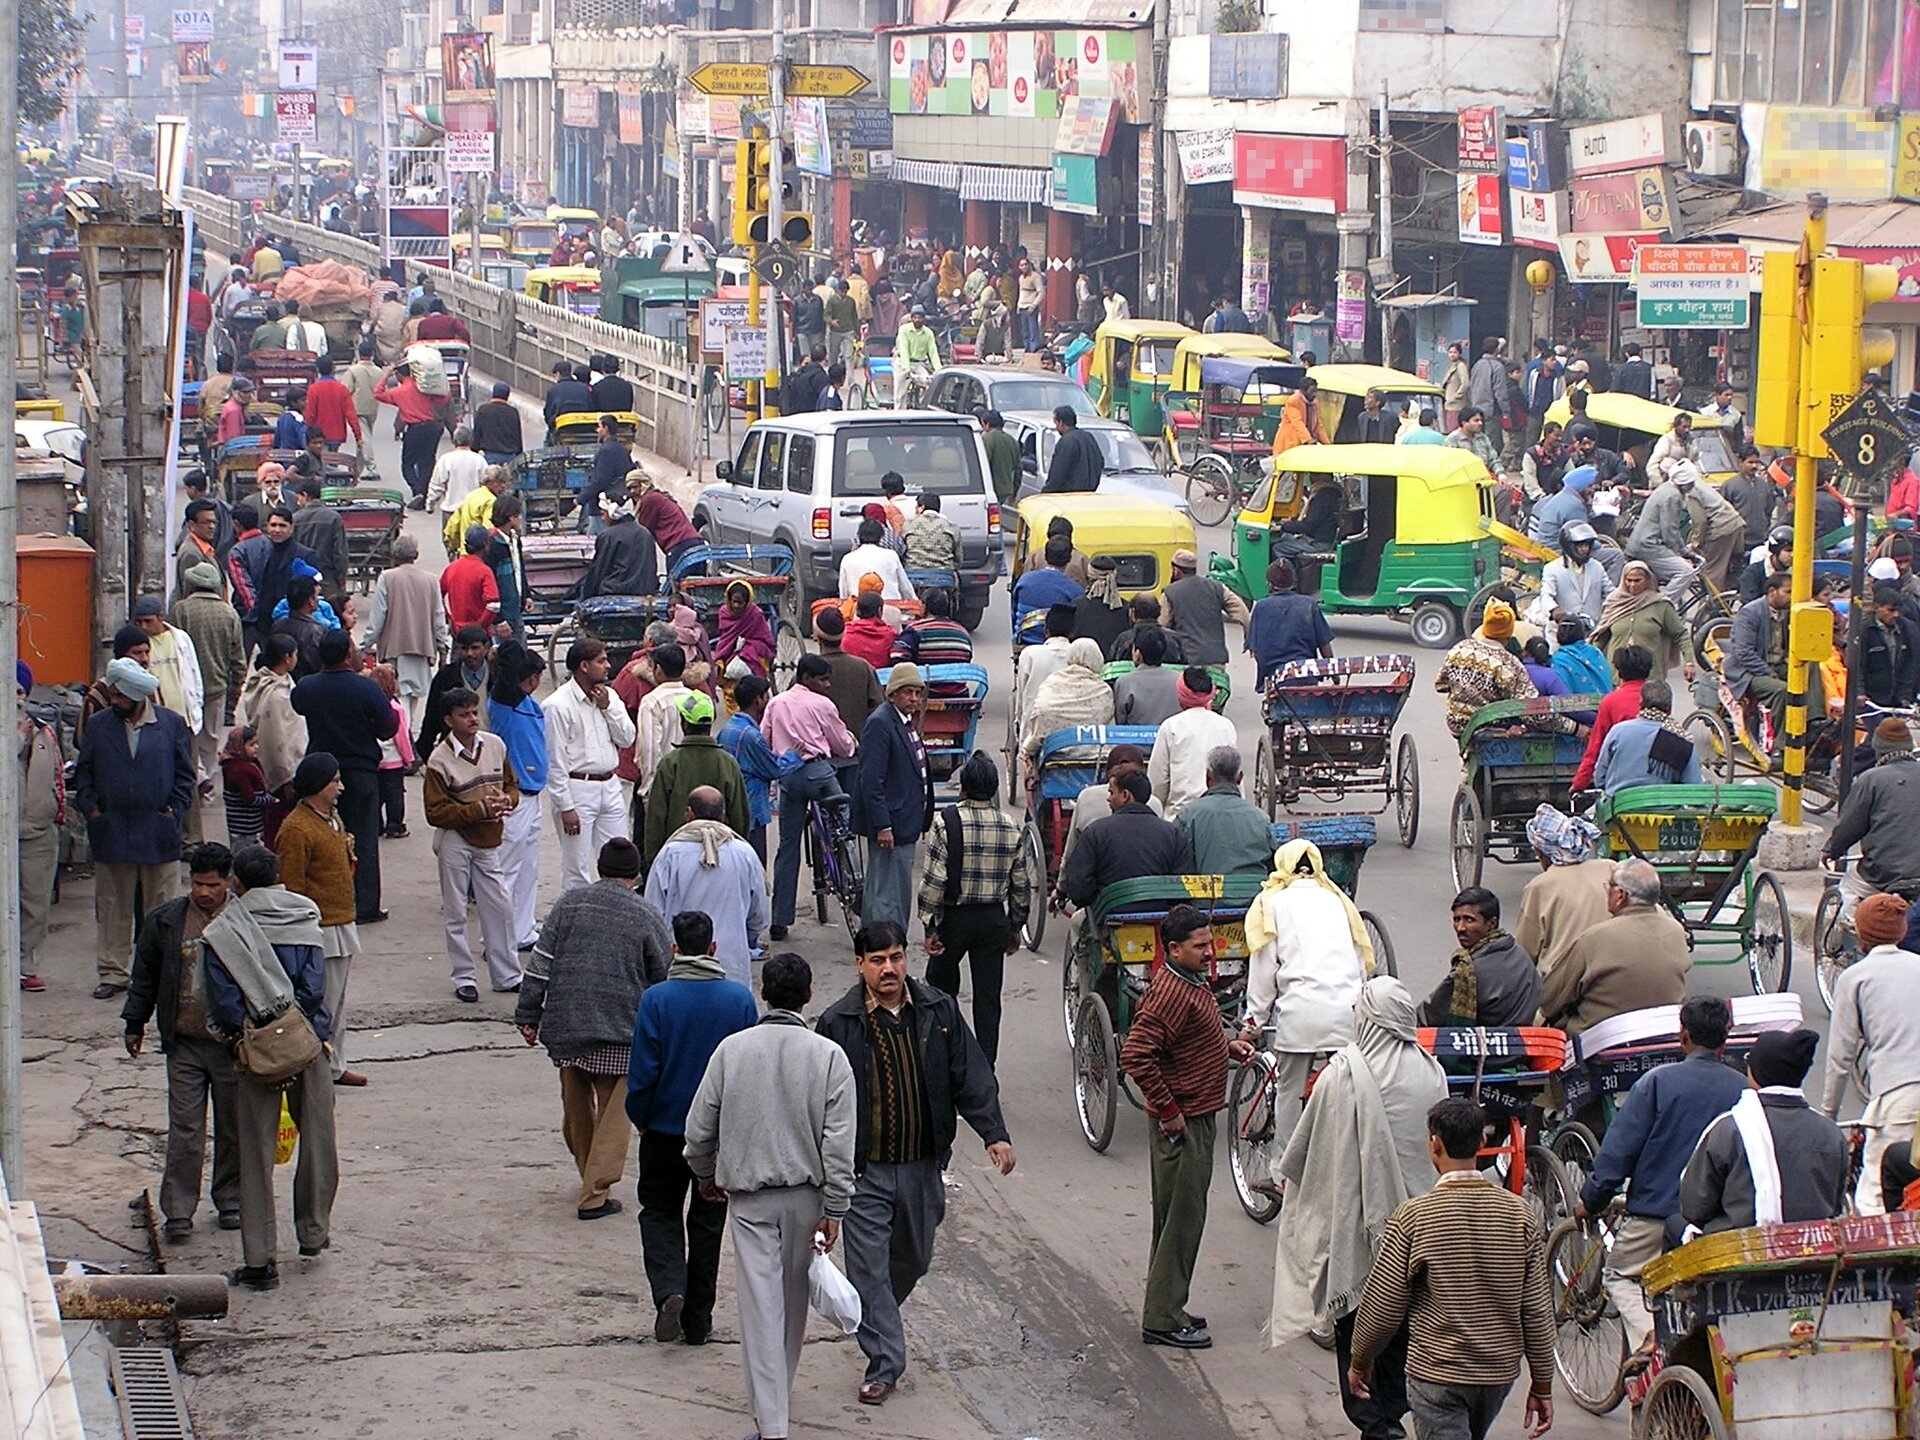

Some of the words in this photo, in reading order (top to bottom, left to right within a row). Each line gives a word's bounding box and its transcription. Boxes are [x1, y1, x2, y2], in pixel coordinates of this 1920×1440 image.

[174, 12, 211, 24] KOTA
[284, 103, 309, 114] 488
[447, 133, 489, 142] CHHABRA
[449, 148, 490, 156] EMPORIUM
[1592, 188, 1636, 215] TITAN
[1653, 248, 1679, 259] दिल्ली
[1685, 250, 1703, 259] नगर
[1711, 248, 1734, 259] निगम
[772, 263, 783, 280] 9
[1684, 261, 1706, 272] चौक
[1708, 261, 1727, 272] क्षेत्र
[1730, 260, 1740, 271] में
[1650, 279, 1684, 289] आपका
[1689, 279, 1720, 289] स्वागत
[1679, 300, 1706, 313] मोहन
[1712, 300, 1735, 312] शर्मा
[1829, 418, 1868, 438] HERITAGE
[1869, 418, 1907, 440] BUILDING
[1858, 434, 1875, 465] 8
